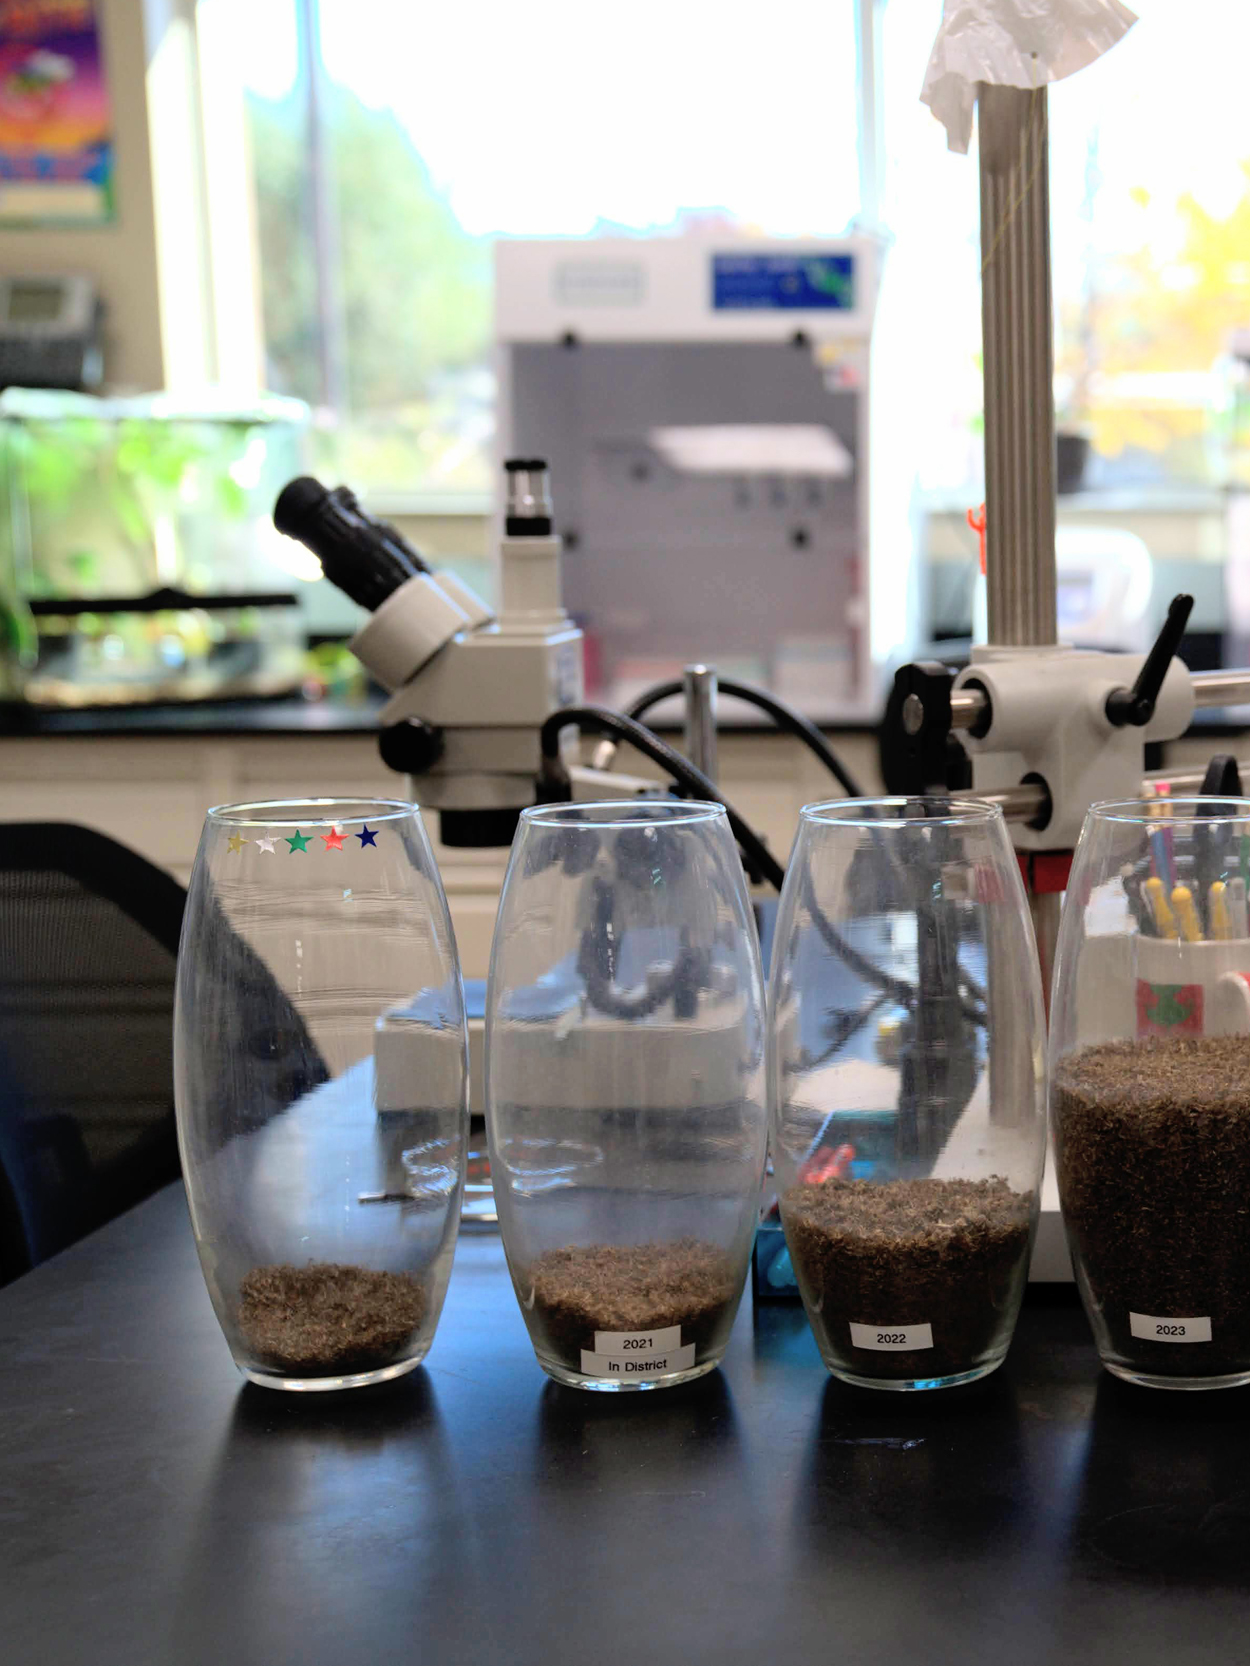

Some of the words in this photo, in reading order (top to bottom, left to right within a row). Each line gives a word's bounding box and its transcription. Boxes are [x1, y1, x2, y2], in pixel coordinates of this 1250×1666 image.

[1156, 1324, 1186, 1336] 2023
[623, 1338, 653, 1349] 2021
[876, 1333, 907, 1344] 2022
[608, 1361, 620, 1372] In
[625, 1359, 667, 1372] District
